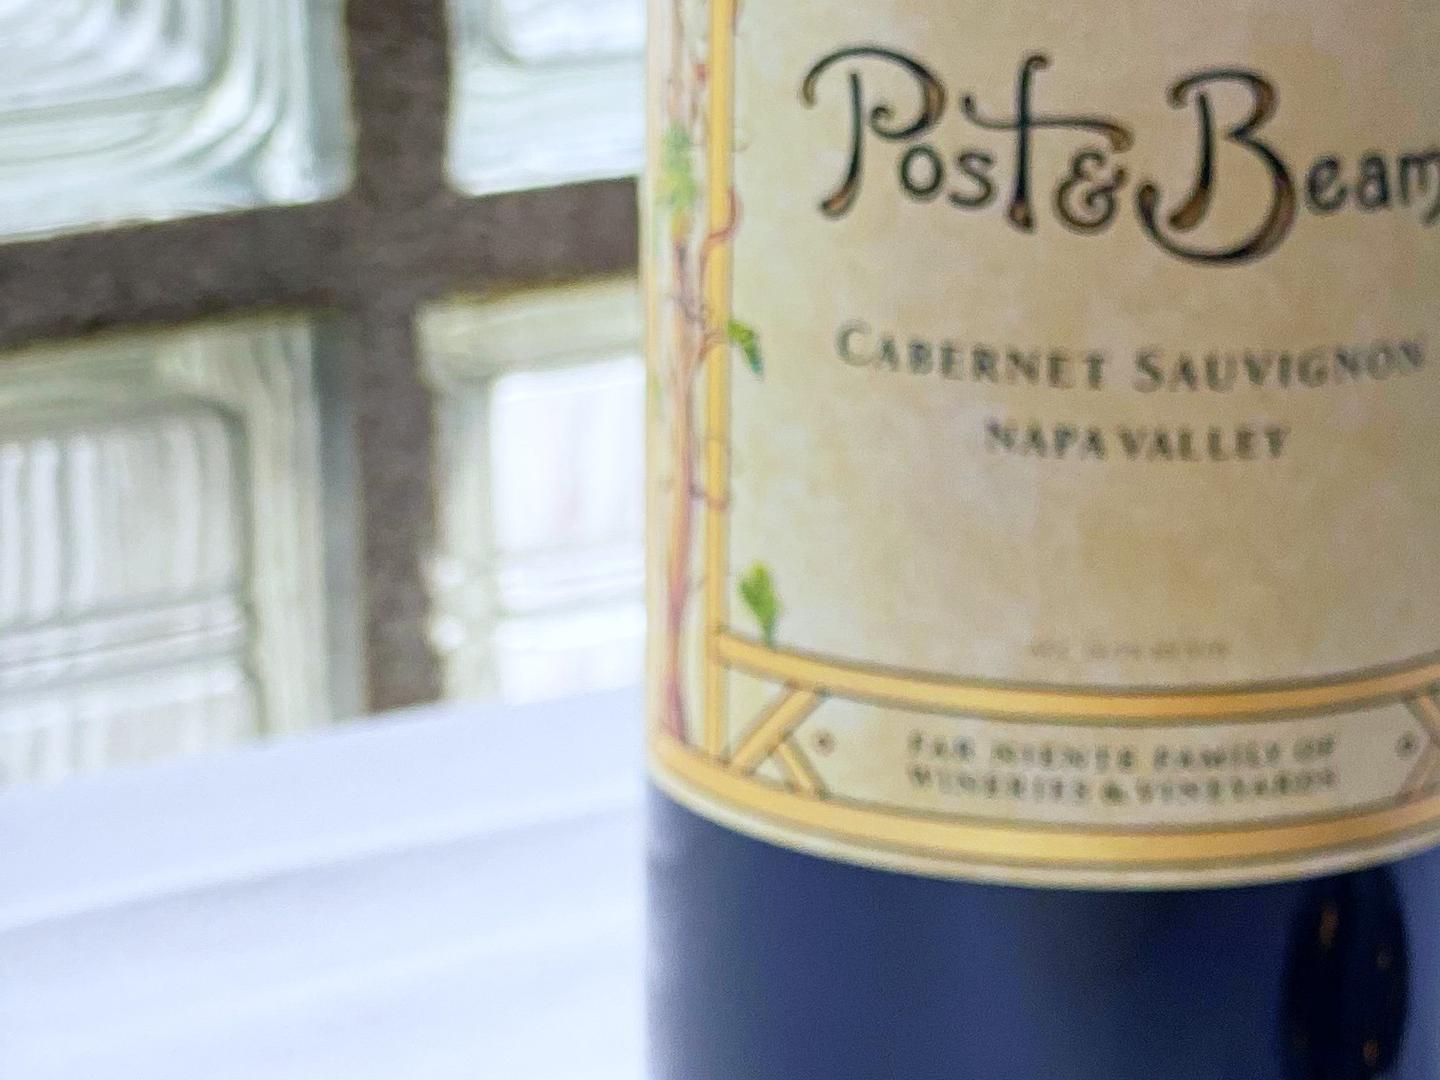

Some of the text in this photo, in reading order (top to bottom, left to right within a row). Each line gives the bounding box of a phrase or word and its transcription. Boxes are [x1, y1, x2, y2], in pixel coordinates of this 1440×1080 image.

[801, 45, 1132, 234] Post
[1055, 145, 1128, 236] &
[834, 318, 1427, 393] CABERNET SAUVIGNON
[985, 418, 1291, 463] NAPA VALLEY
